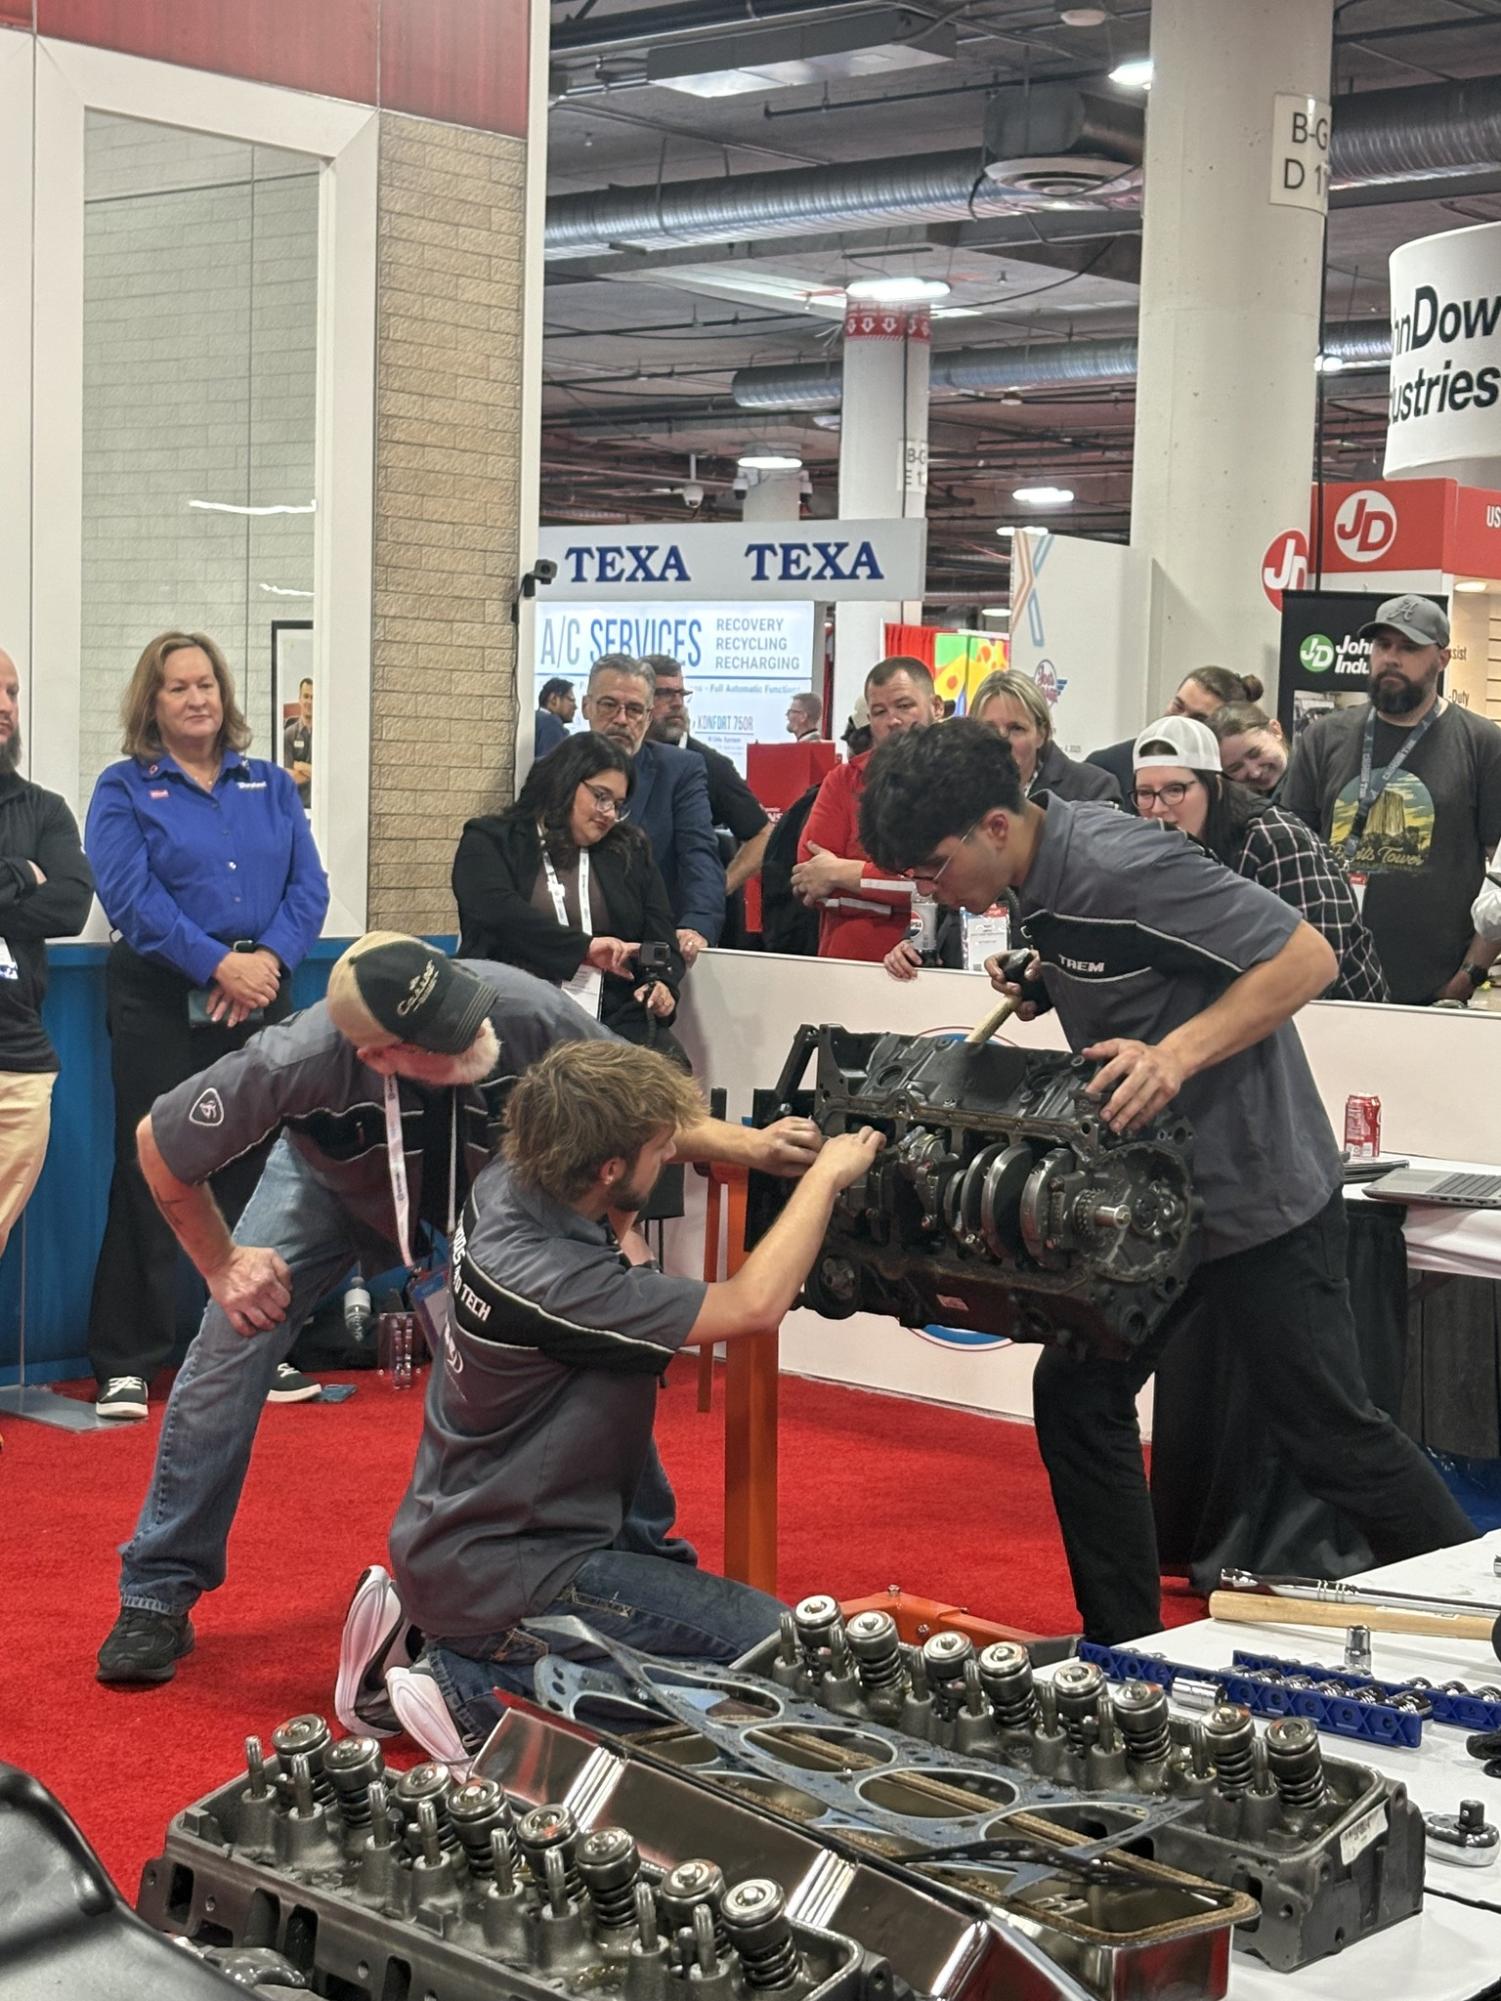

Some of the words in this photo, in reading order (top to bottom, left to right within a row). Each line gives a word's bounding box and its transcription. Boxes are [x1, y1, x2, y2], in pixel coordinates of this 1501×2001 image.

[1292, 111, 1328, 151] B-G
[1284, 158, 1305, 190] D
[1392, 360, 1501, 424] ustries
[1337, 499, 1394, 552] JD
[565, 545, 691, 583] TEXA
[745, 541, 885, 581] TEXA
[540, 616, 581, 668] A/C
[590, 618, 702, 668] SERVICES
[715, 636, 788, 651] RECYCLING
[716, 618, 784, 632] RECOVERY
[715, 656, 800, 670] RECHARGING
[1300, 638, 1334, 667] JD
[461, 1283, 491, 1322] TECH
